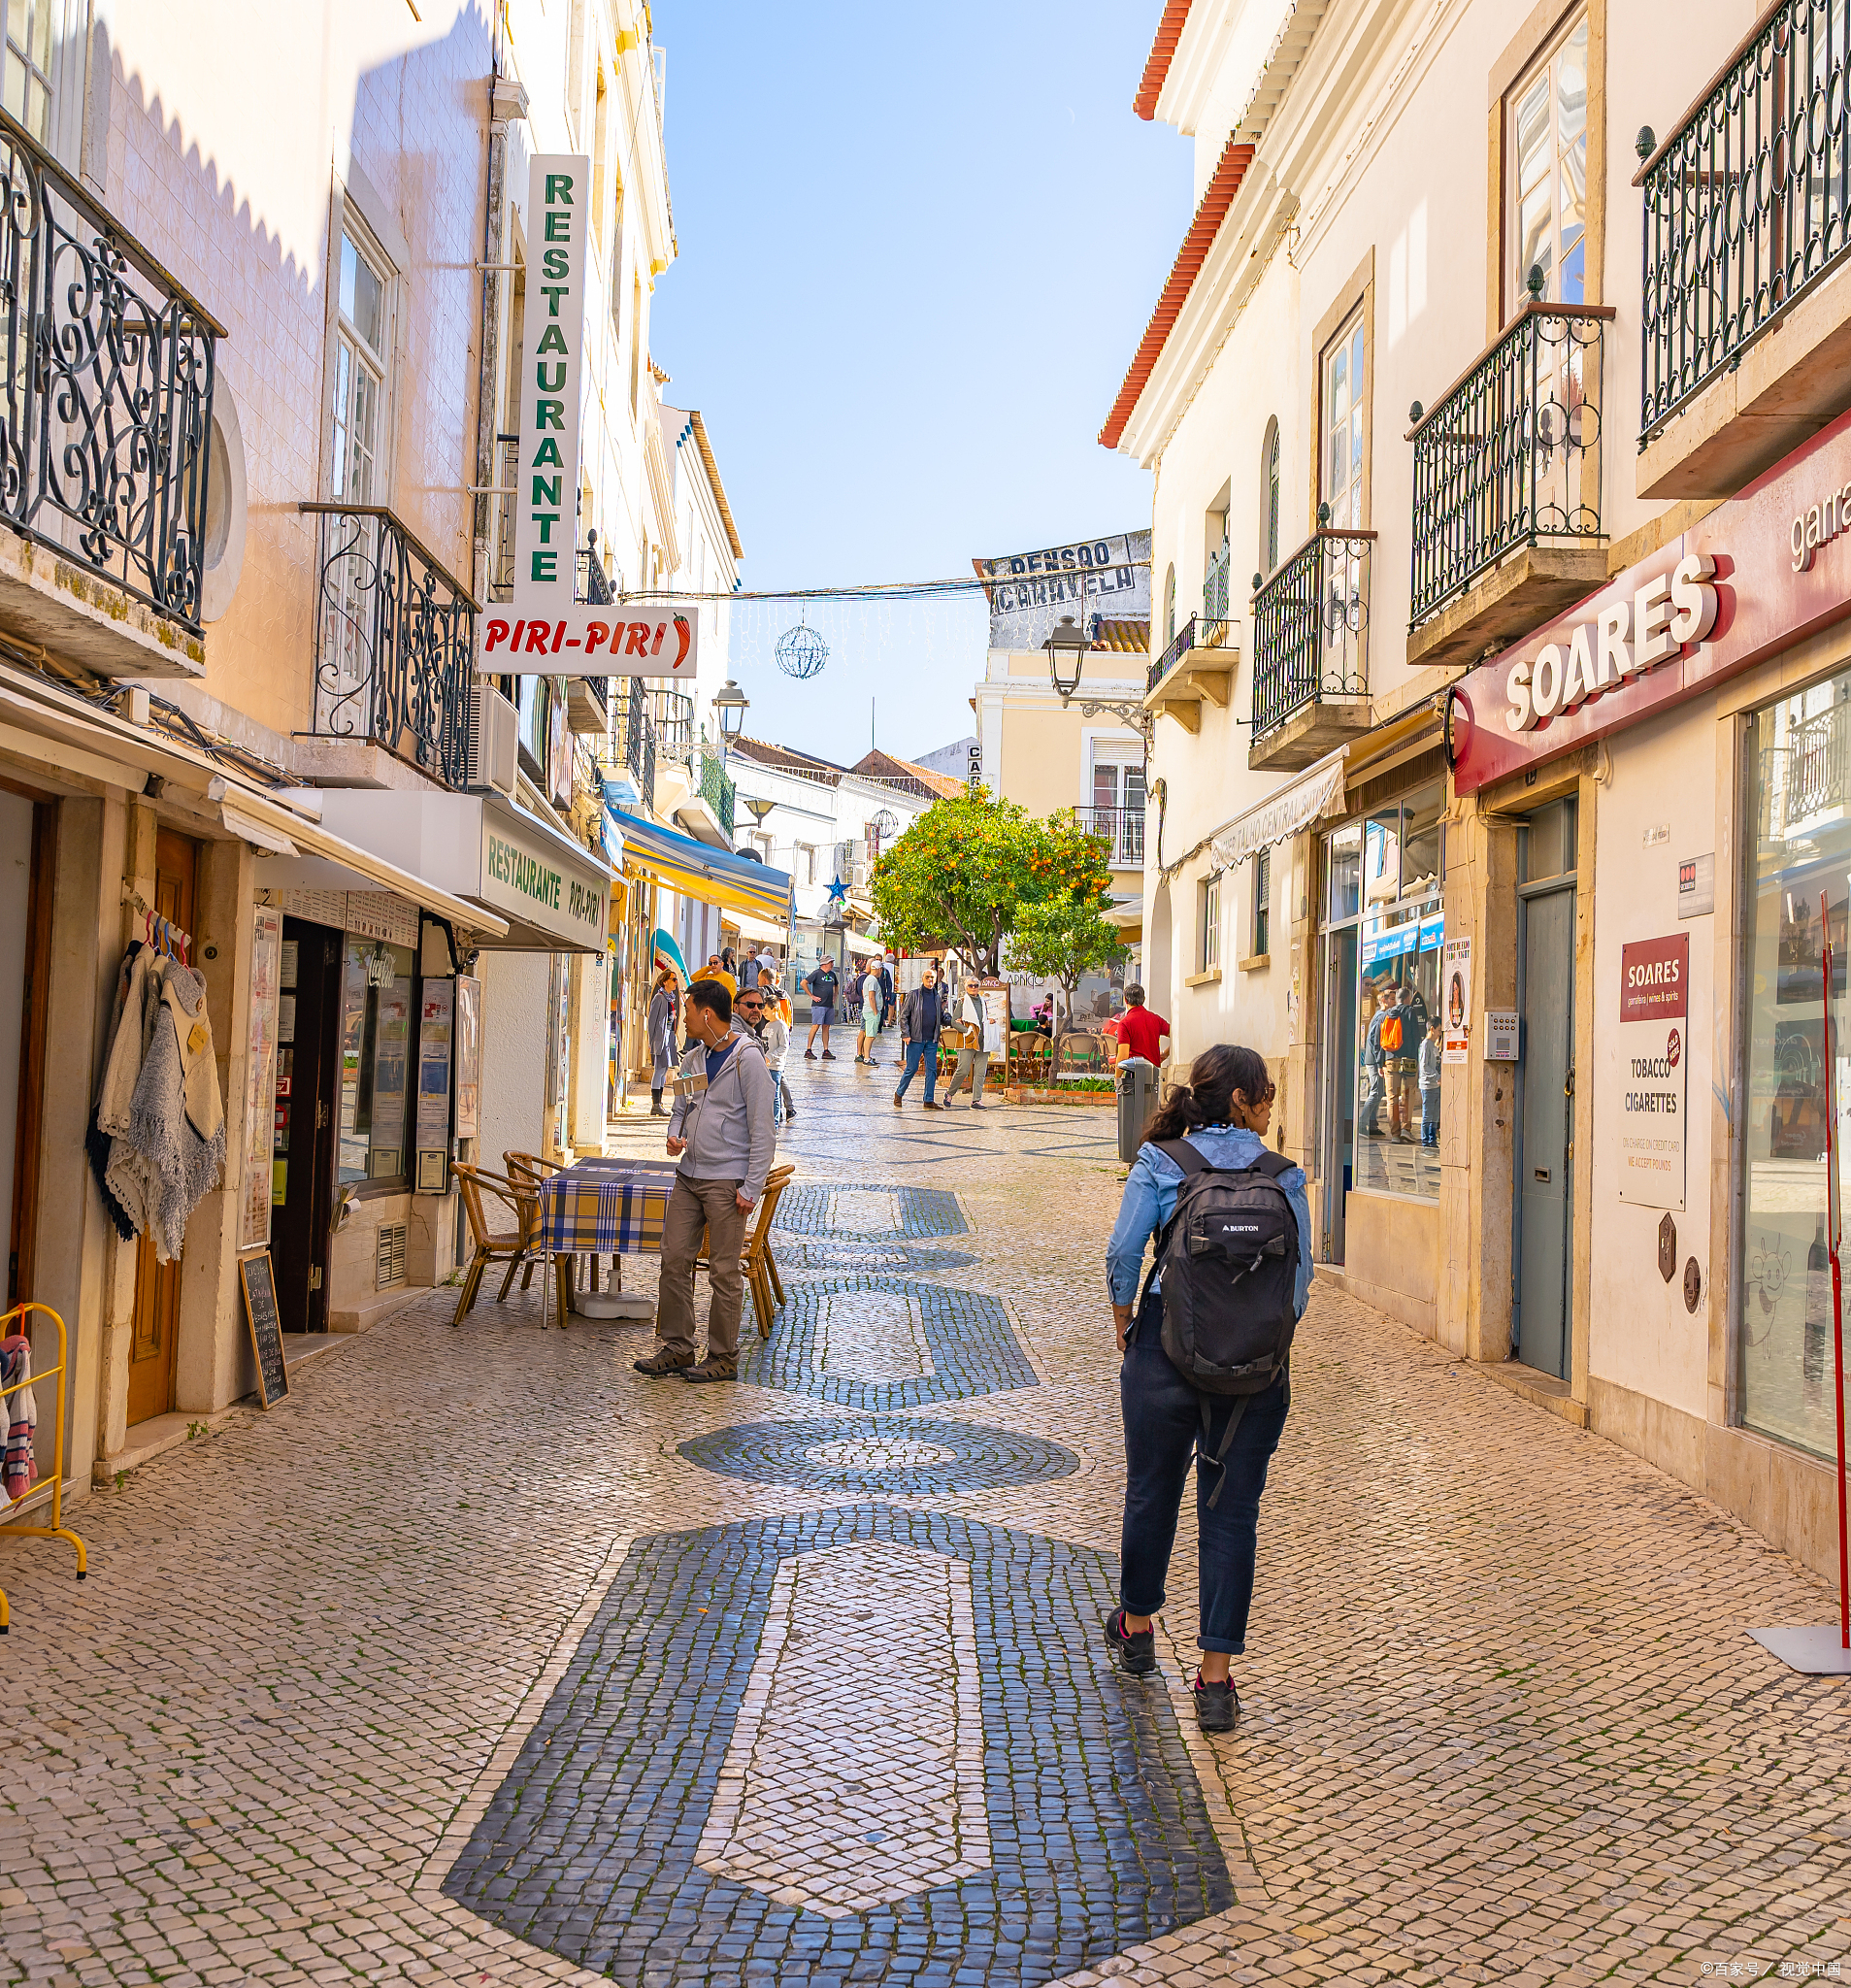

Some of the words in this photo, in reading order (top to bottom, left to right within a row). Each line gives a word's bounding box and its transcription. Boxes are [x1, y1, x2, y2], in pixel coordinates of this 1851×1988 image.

[530, 174, 575, 582] RESTAURANTE
[485, 618, 669, 657] PIRI-PIRI
[1505, 553, 1719, 732] SOARES
[1262, 798, 1299, 841] CENTRAL
[488, 835, 562, 911] RESTAURANTE
[568, 880, 600, 929] PIRI-PIRI
[1628, 958, 1679, 988] SOARES
[1631, 1057, 1671, 1078] TOBACCO
[1625, 1092, 1677, 1114] CIGARETTES
[1630, 1138, 1646, 1150] CHARGE
[1646, 1139, 1653, 1150] ON
[1653, 1140, 1668, 1151] CREDIT
[1668, 1141, 1680, 1153] CARD
[1628, 1155, 1636, 1168] WE
[1636, 1156, 1652, 1170] ACCEPT
[1652, 1158, 1671, 1172] POUNDS
